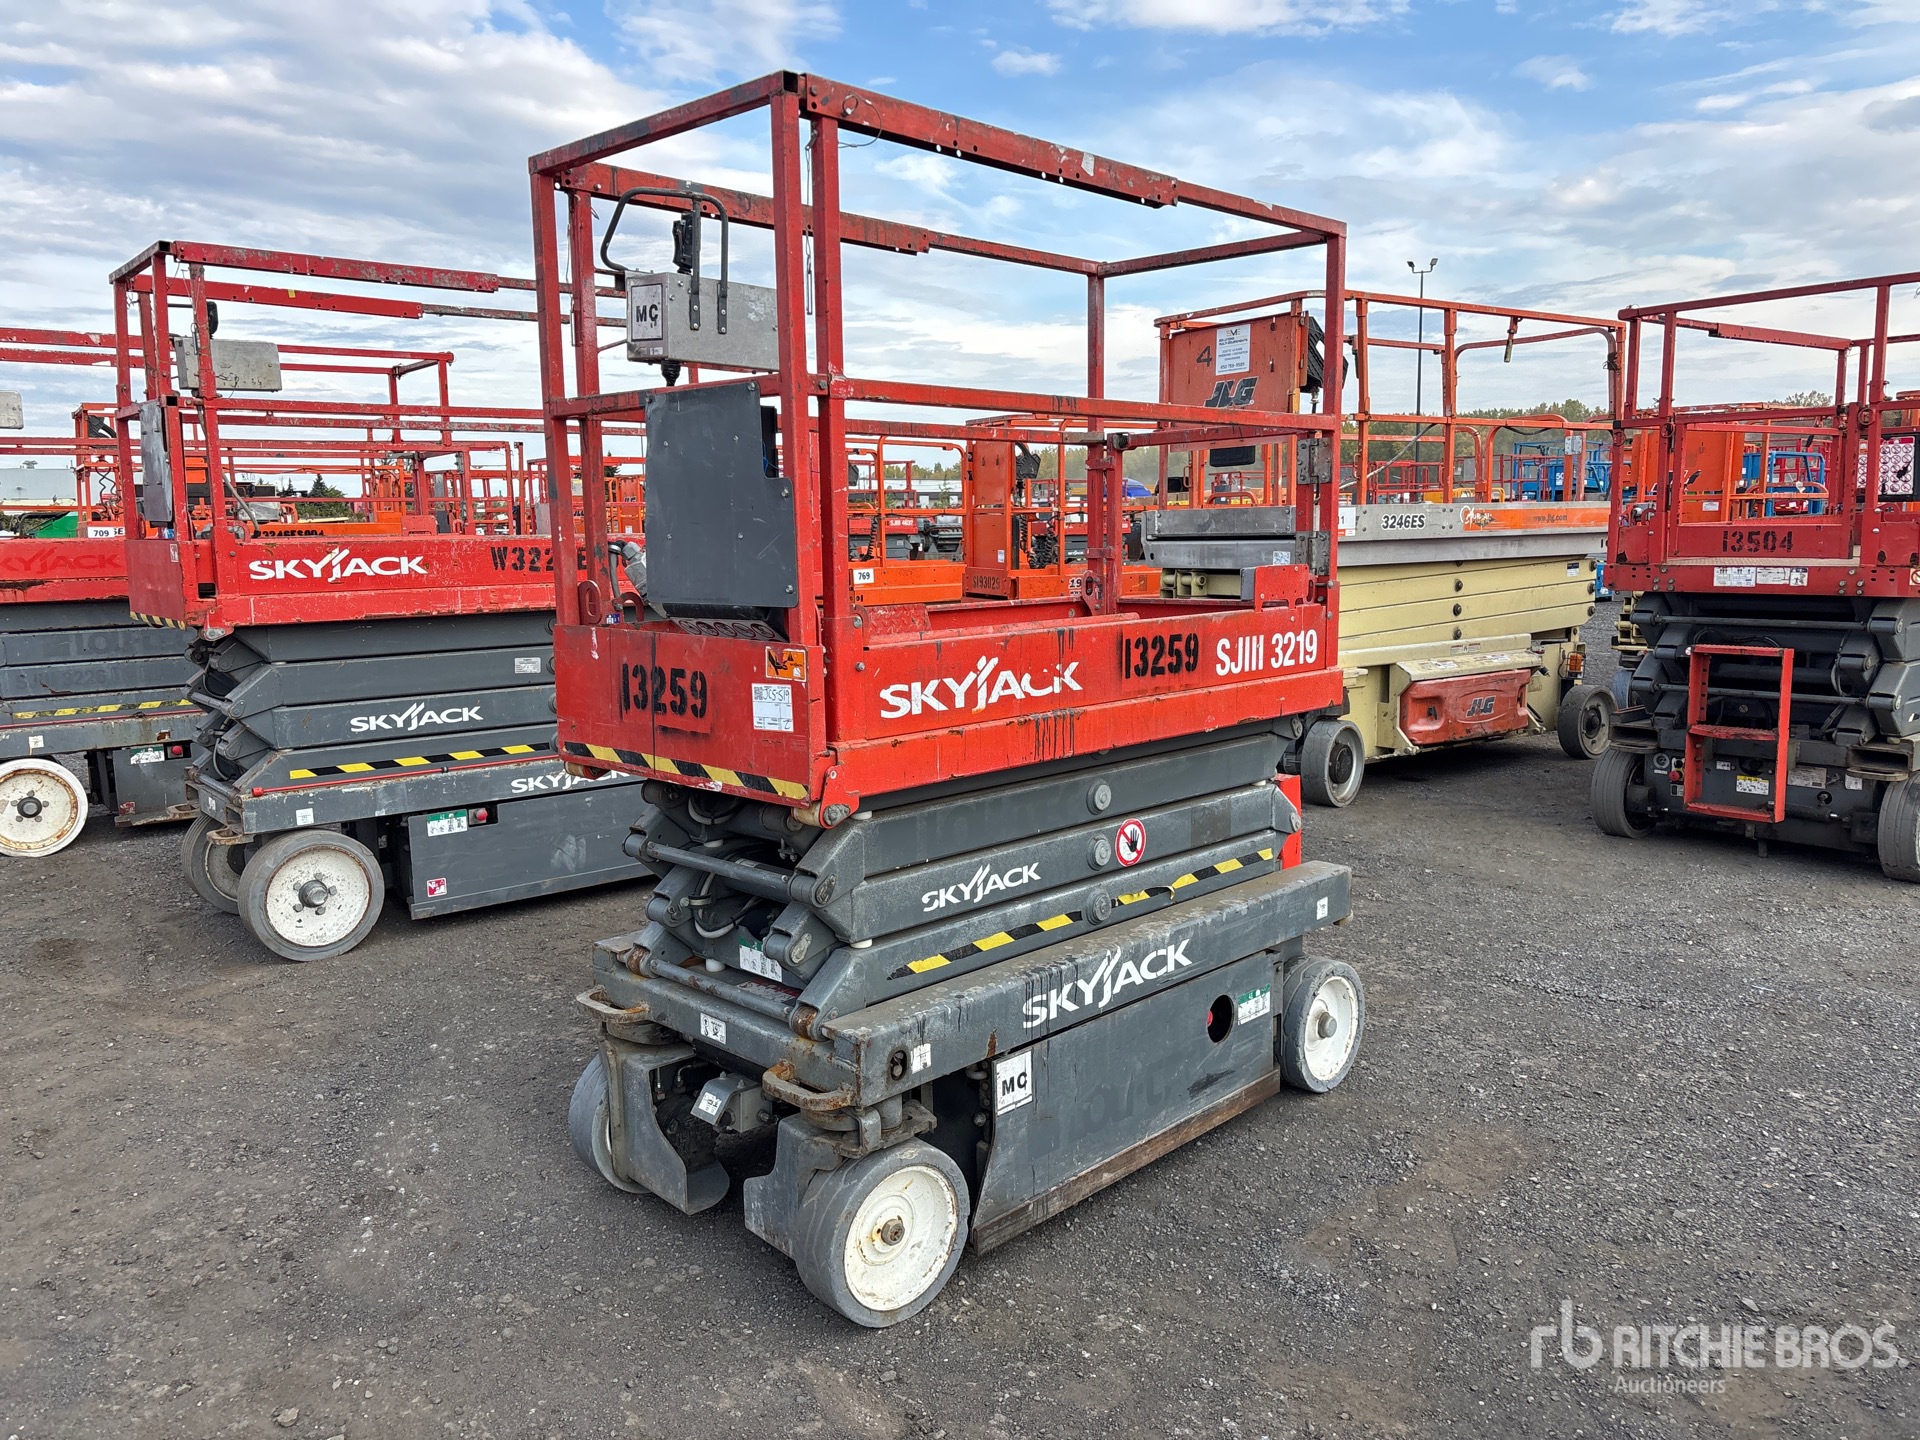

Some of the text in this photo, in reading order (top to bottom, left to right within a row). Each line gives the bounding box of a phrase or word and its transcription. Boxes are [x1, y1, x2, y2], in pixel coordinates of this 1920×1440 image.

[635, 303, 659, 323] MC
[1196, 345, 1213, 368] 4
[93, 529, 110, 537] 709
[1381, 514, 1427, 530] 3246ES
[248, 546, 429, 583] SKYJACK
[858, 571, 871, 580] 769
[1124, 628, 1318, 680] 13259 SJIII 3219
[621, 662, 708, 720] 13259
[879, 655, 1083, 719] SKYJACK
[349, 701, 484, 733] SKYJACK
[1466, 696, 1497, 718] JLG
[921, 862, 1042, 912] SKYJACK
[1022, 938, 1193, 1030] SKYJACK
[1001, 1071, 1028, 1097] MC
